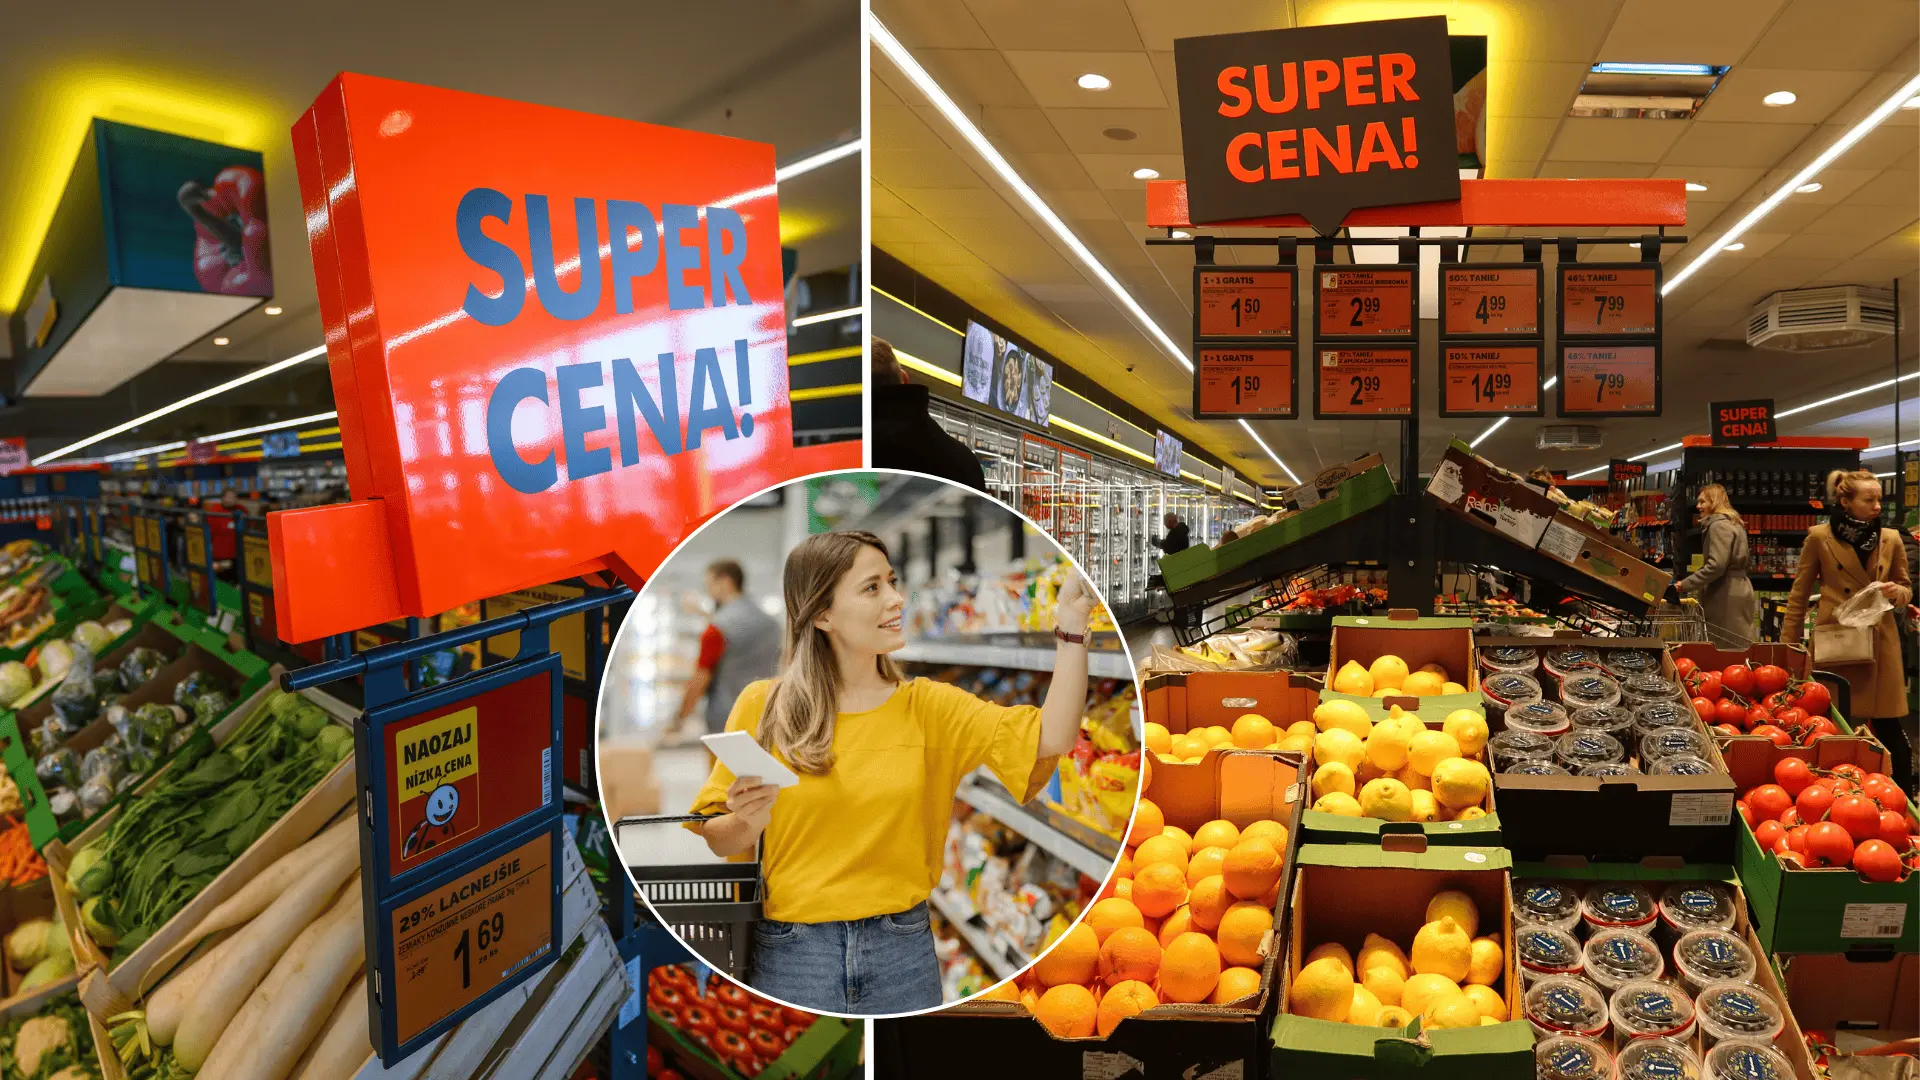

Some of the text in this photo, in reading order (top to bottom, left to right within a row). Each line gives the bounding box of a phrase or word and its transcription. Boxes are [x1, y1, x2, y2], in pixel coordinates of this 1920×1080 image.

[1217, 52, 1420, 118] SUPER
[1225, 117, 1419, 183] CENA!
[455, 187, 752, 327] SUPER
[1449, 274, 1500, 282] 50% TANIEJ
[1587, 274, 1617, 282] TANIEJ
[1222, 354, 1254, 362] GRATIS
[1449, 352, 1500, 360] 50% TANIEJ
[1587, 352, 1617, 360] TANIEJ
[486, 338, 754, 495] CENA!
[1720, 407, 1768, 422] SUPER
[1721, 422, 1768, 437] CENA!
[403, 722, 472, 766] NAOZAJ
[405, 753, 472, 791] NÍZKA CENA
[399, 858, 521, 934] 29% LACNEJŠIE
[478, 912, 504, 951] 69
